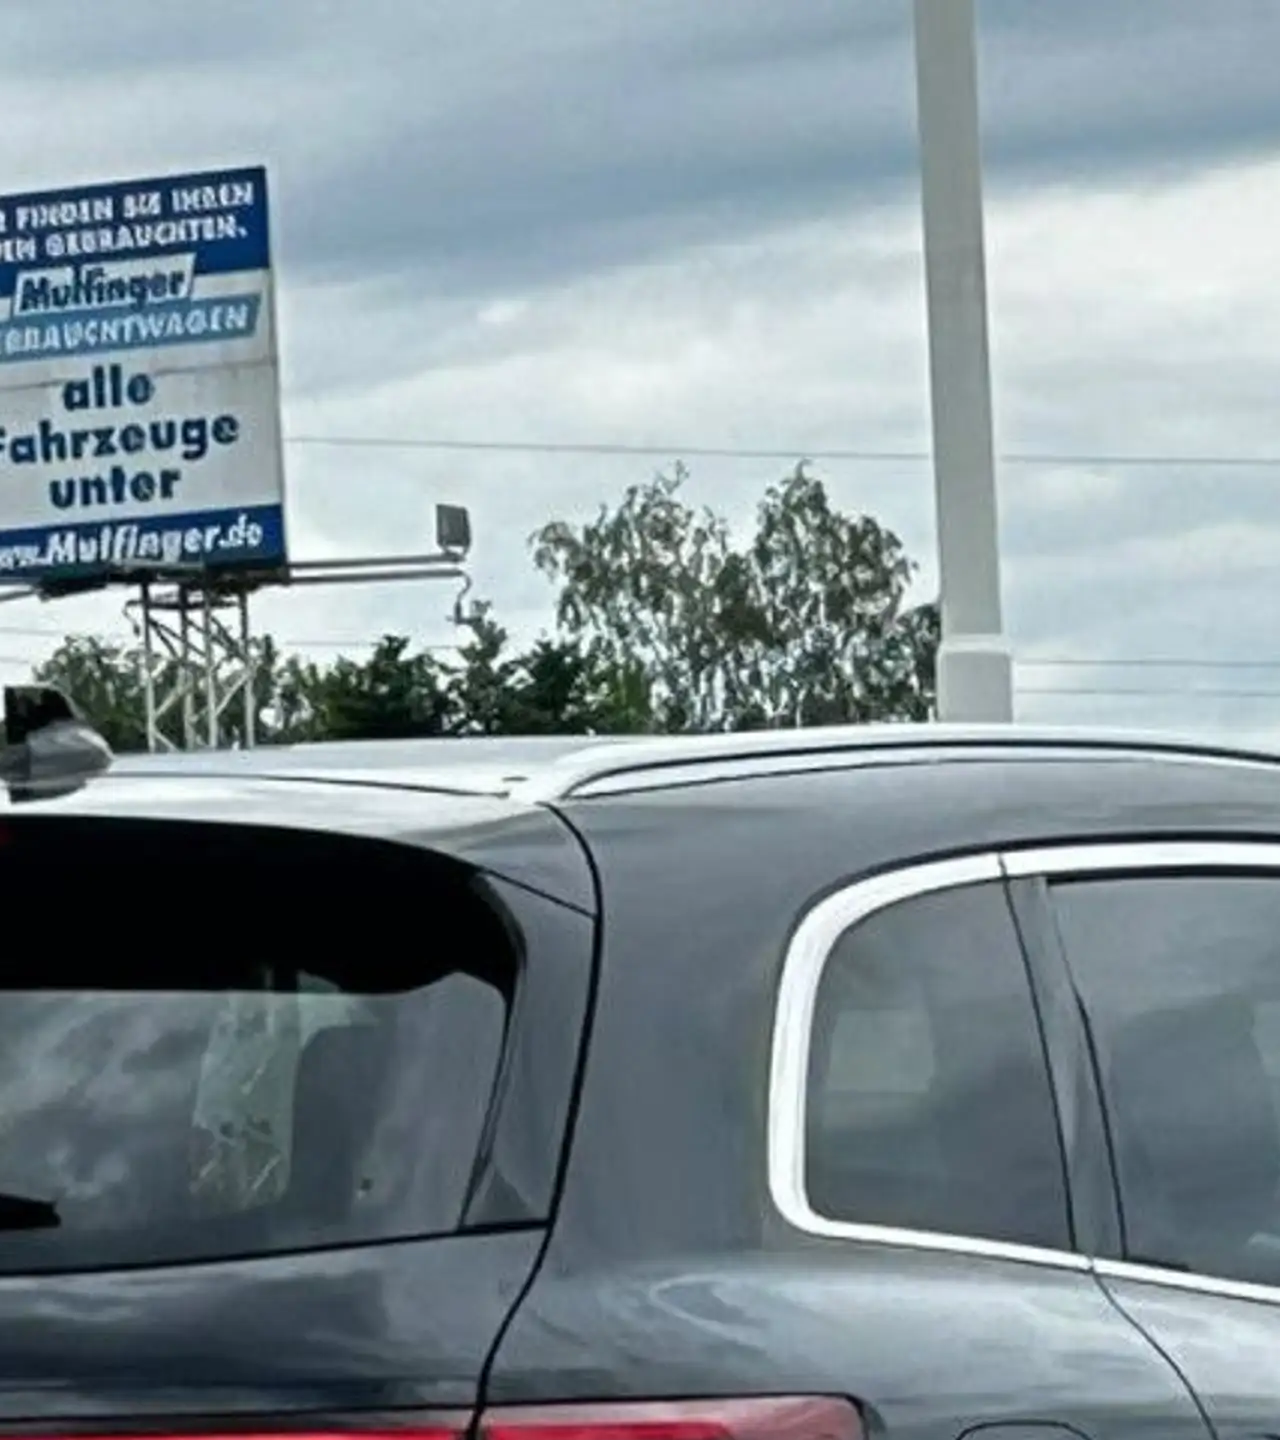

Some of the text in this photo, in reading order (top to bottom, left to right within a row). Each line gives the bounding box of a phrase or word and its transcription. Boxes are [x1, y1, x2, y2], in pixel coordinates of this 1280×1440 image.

[16, 196, 113, 231] FINDEN
[171, 181, 254, 212] IHREN
[62, 364, 155, 411] alle
[49, 465, 181, 508] unter
